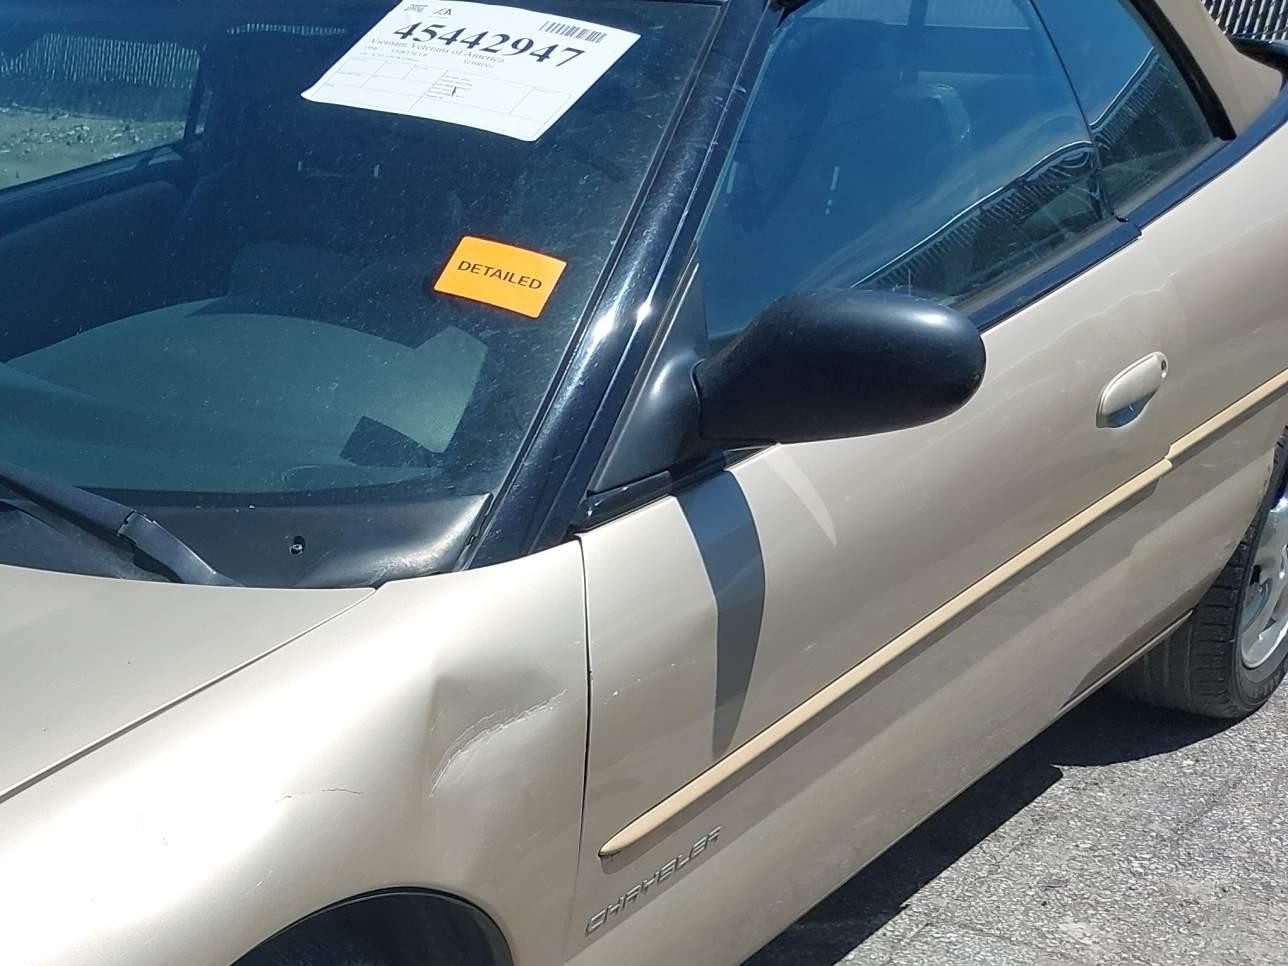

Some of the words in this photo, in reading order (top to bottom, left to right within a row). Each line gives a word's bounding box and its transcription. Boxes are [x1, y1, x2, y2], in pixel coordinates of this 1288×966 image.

[392, 21, 586, 67] 45442947
[411, 42, 450, 55] Veterans
[464, 50, 505, 63] America
[457, 260, 543, 290] DETAILED
[585, 825, 722, 936] CHRYSLER
